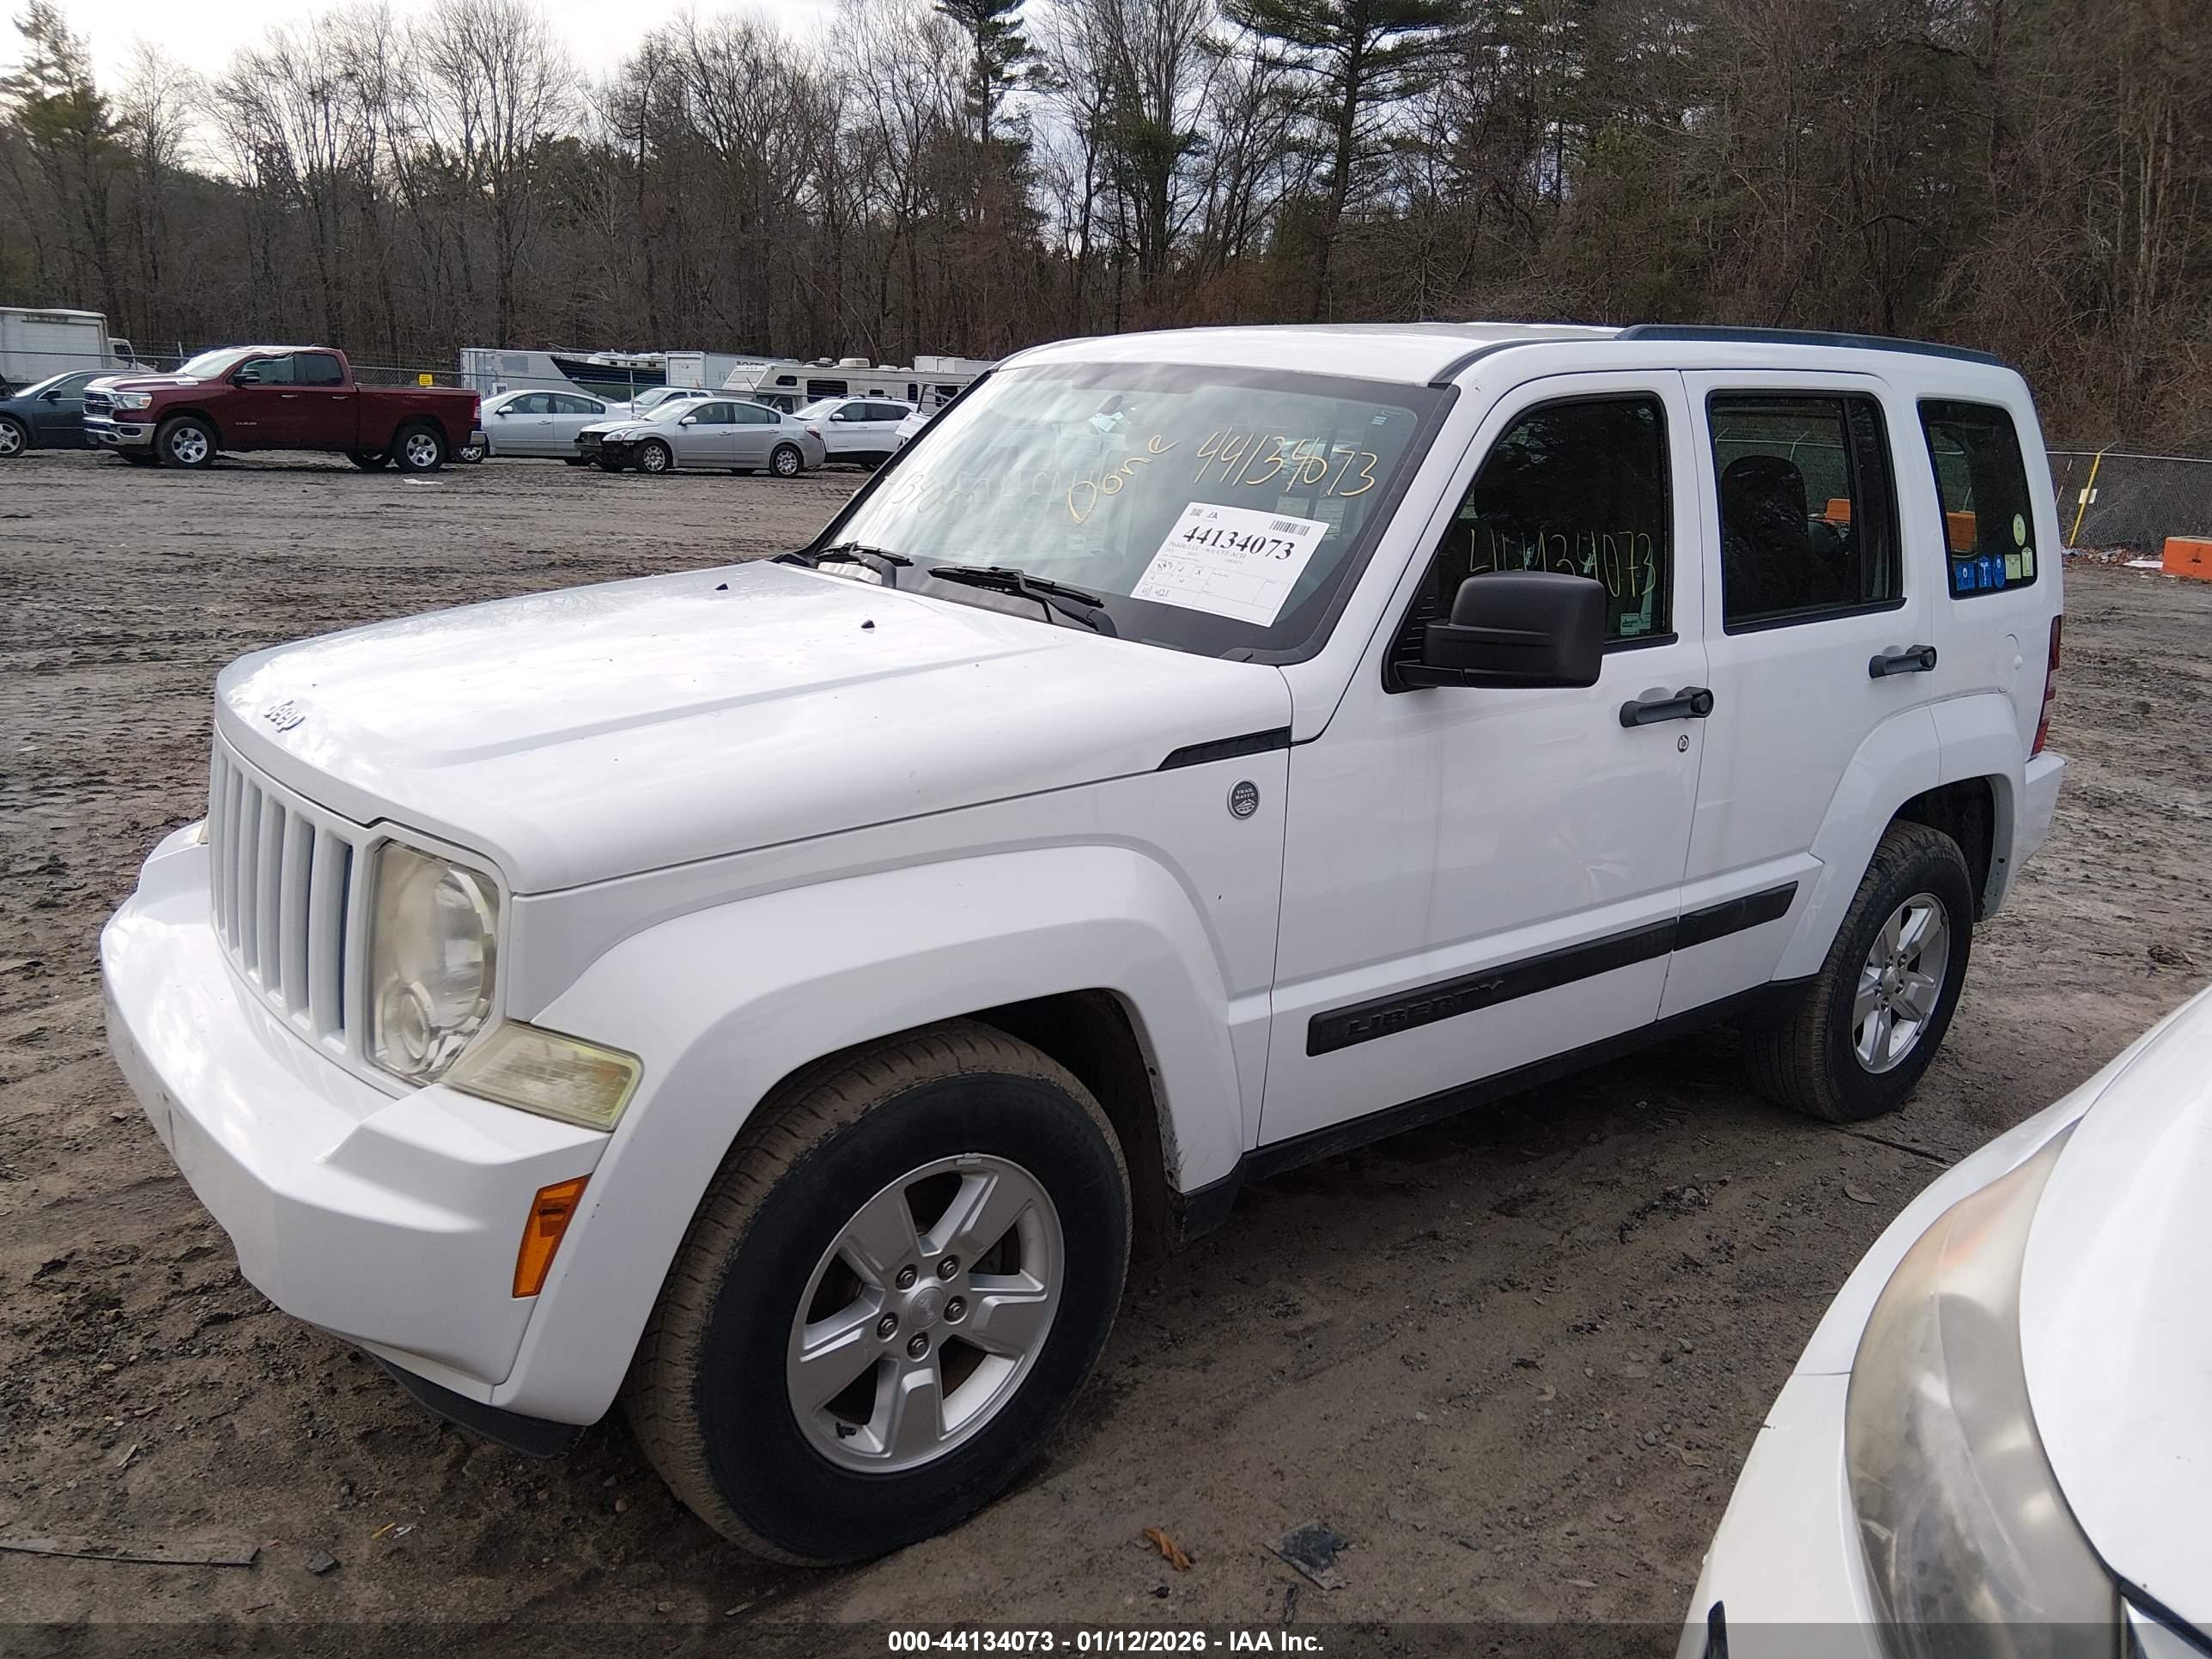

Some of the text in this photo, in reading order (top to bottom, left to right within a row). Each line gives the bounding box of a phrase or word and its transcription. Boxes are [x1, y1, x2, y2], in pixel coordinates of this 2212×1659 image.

[1068, 434, 1180, 523] Done
[1194, 427, 1377, 495] 44134073
[1182, 526, 1295, 560] 44134073
[1347, 980, 1504, 1036] LIBERTY
